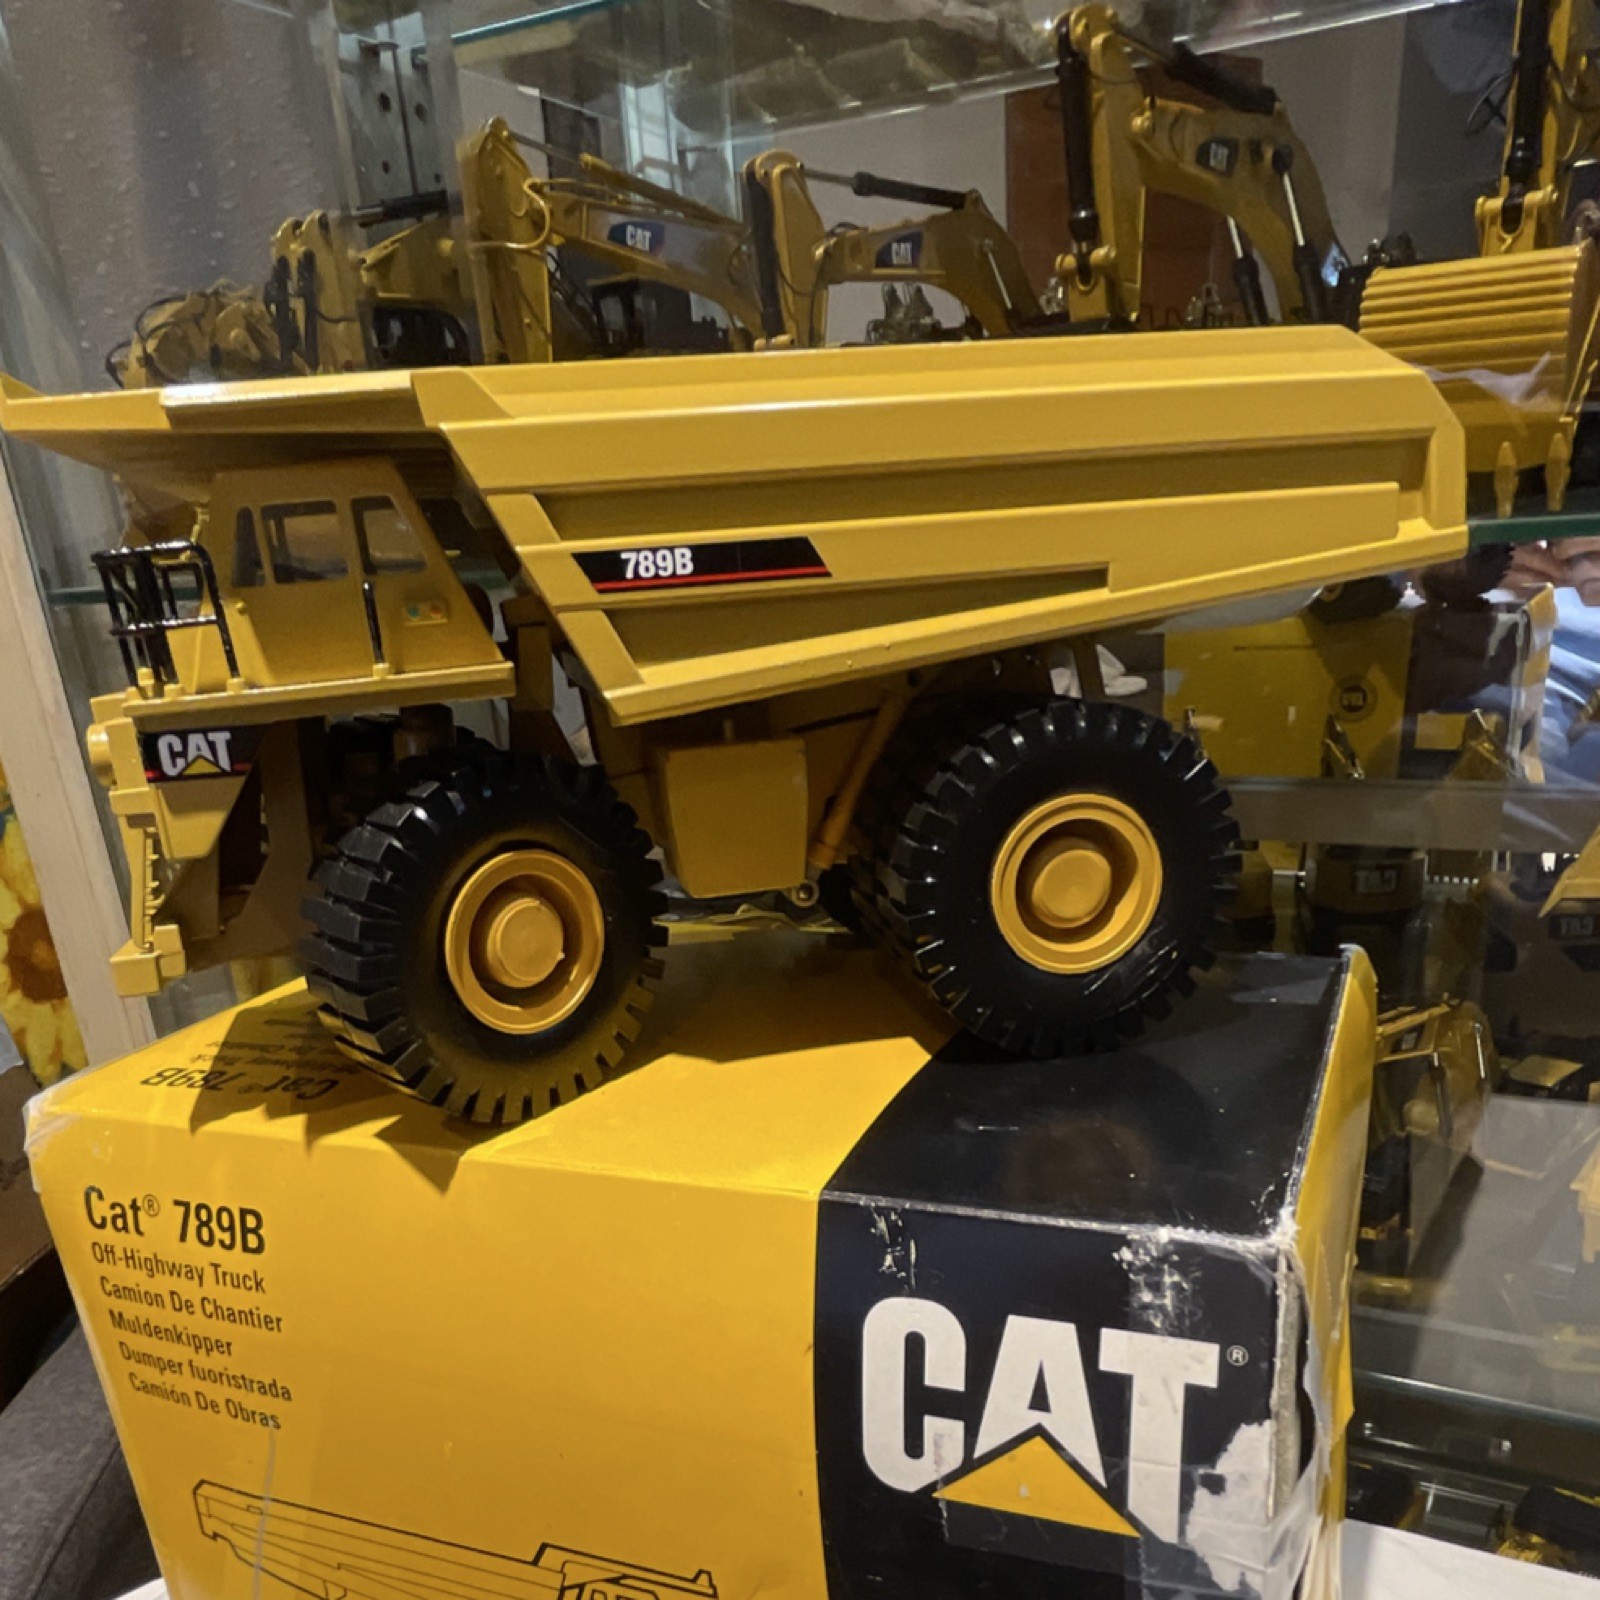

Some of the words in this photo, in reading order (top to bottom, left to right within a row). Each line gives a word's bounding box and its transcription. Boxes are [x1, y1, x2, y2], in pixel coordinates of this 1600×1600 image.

[625, 224, 652, 251] CAT
[620, 547, 694, 580] 789B
[157, 730, 232, 777] CAT
[140, 1067, 247, 1092] 789B
[173, 1198, 266, 1255] 789B
[91, 1241, 204, 1288] Off-Highway
[208, 1262, 266, 1295] Truck
[100, 1275, 165, 1310] Camion
[169, 1289, 196, 1316] De
[200, 1296, 283, 1333] Chantier
[108, 1309, 232, 1357] Muldenkipper
[118, 1341, 184, 1376] Dumper
[188, 1358, 293, 1402] fuoristrada
[128, 1372, 193, 1408] Camión
[195, 1390, 221, 1415] De
[225, 1398, 282, 1431] Obras
